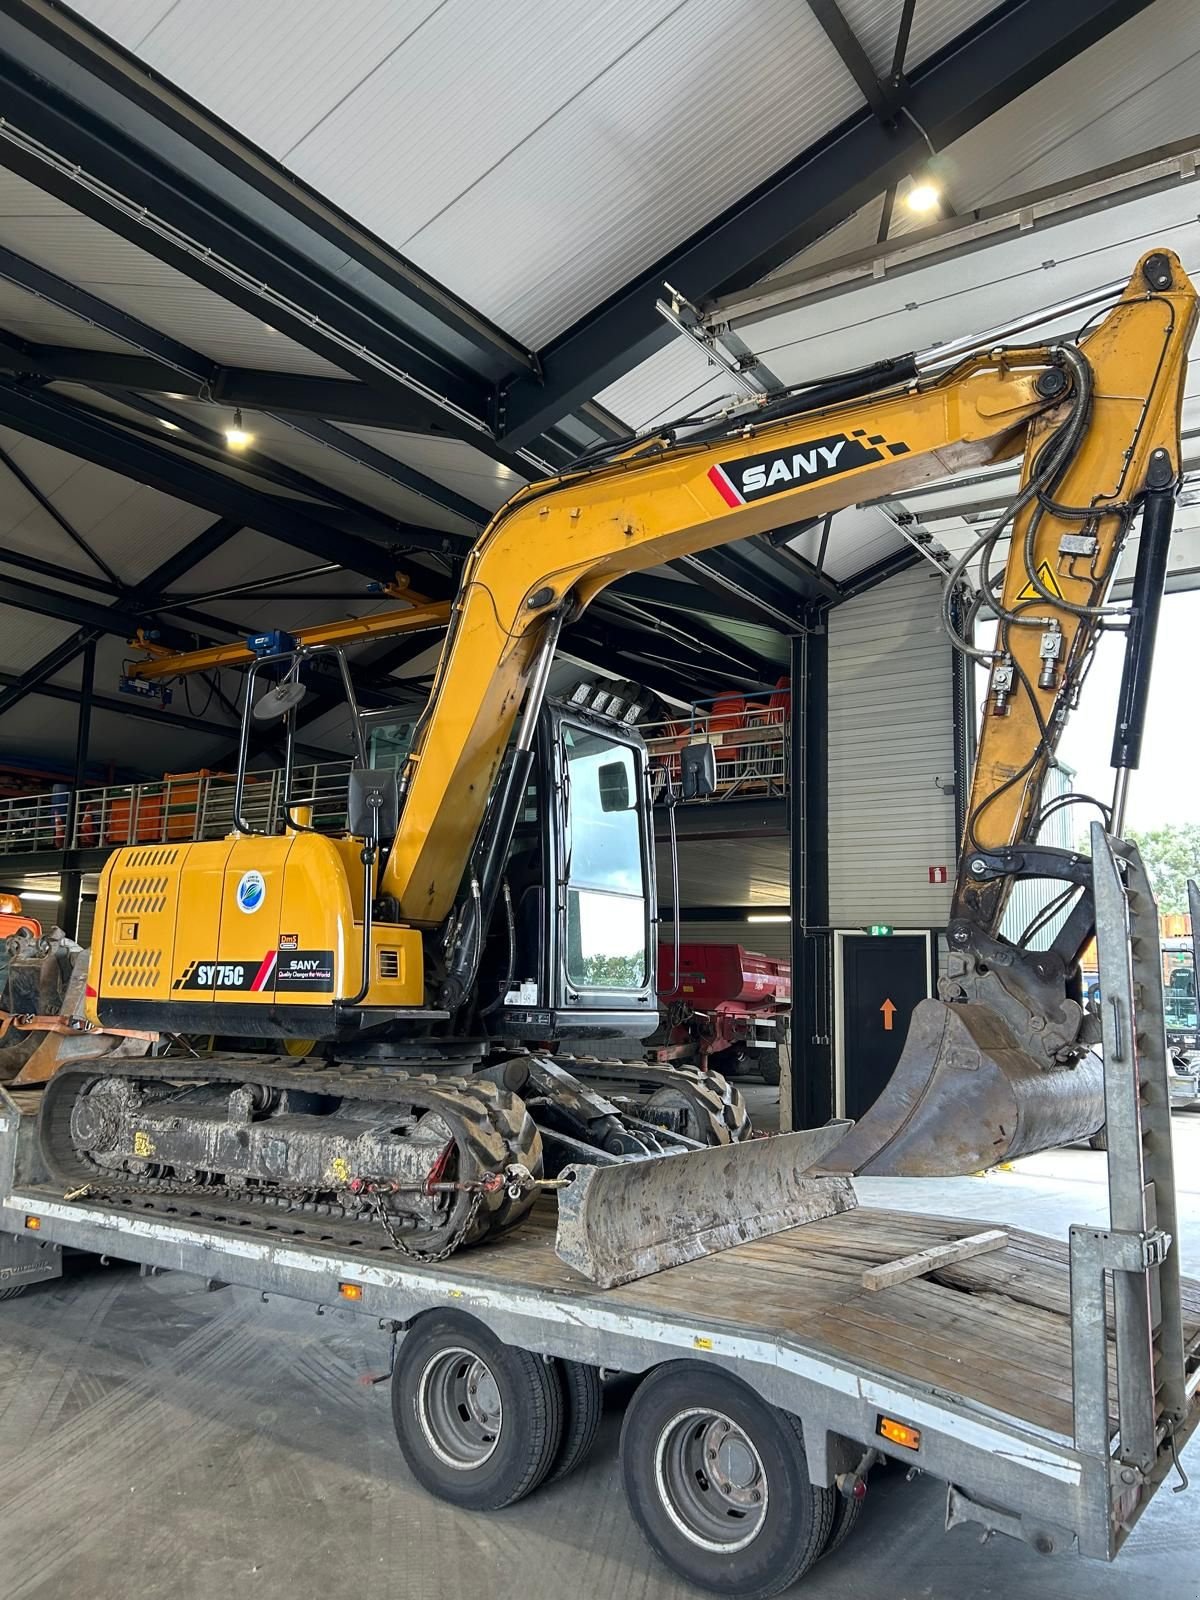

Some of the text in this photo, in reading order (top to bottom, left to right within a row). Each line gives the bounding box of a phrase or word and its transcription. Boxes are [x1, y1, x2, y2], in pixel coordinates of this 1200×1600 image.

[742, 440, 845, 493] SANY
[290, 960, 320, 970] SANY
[278, 971, 292, 979] Quality
[292, 971, 308, 979] Changes
